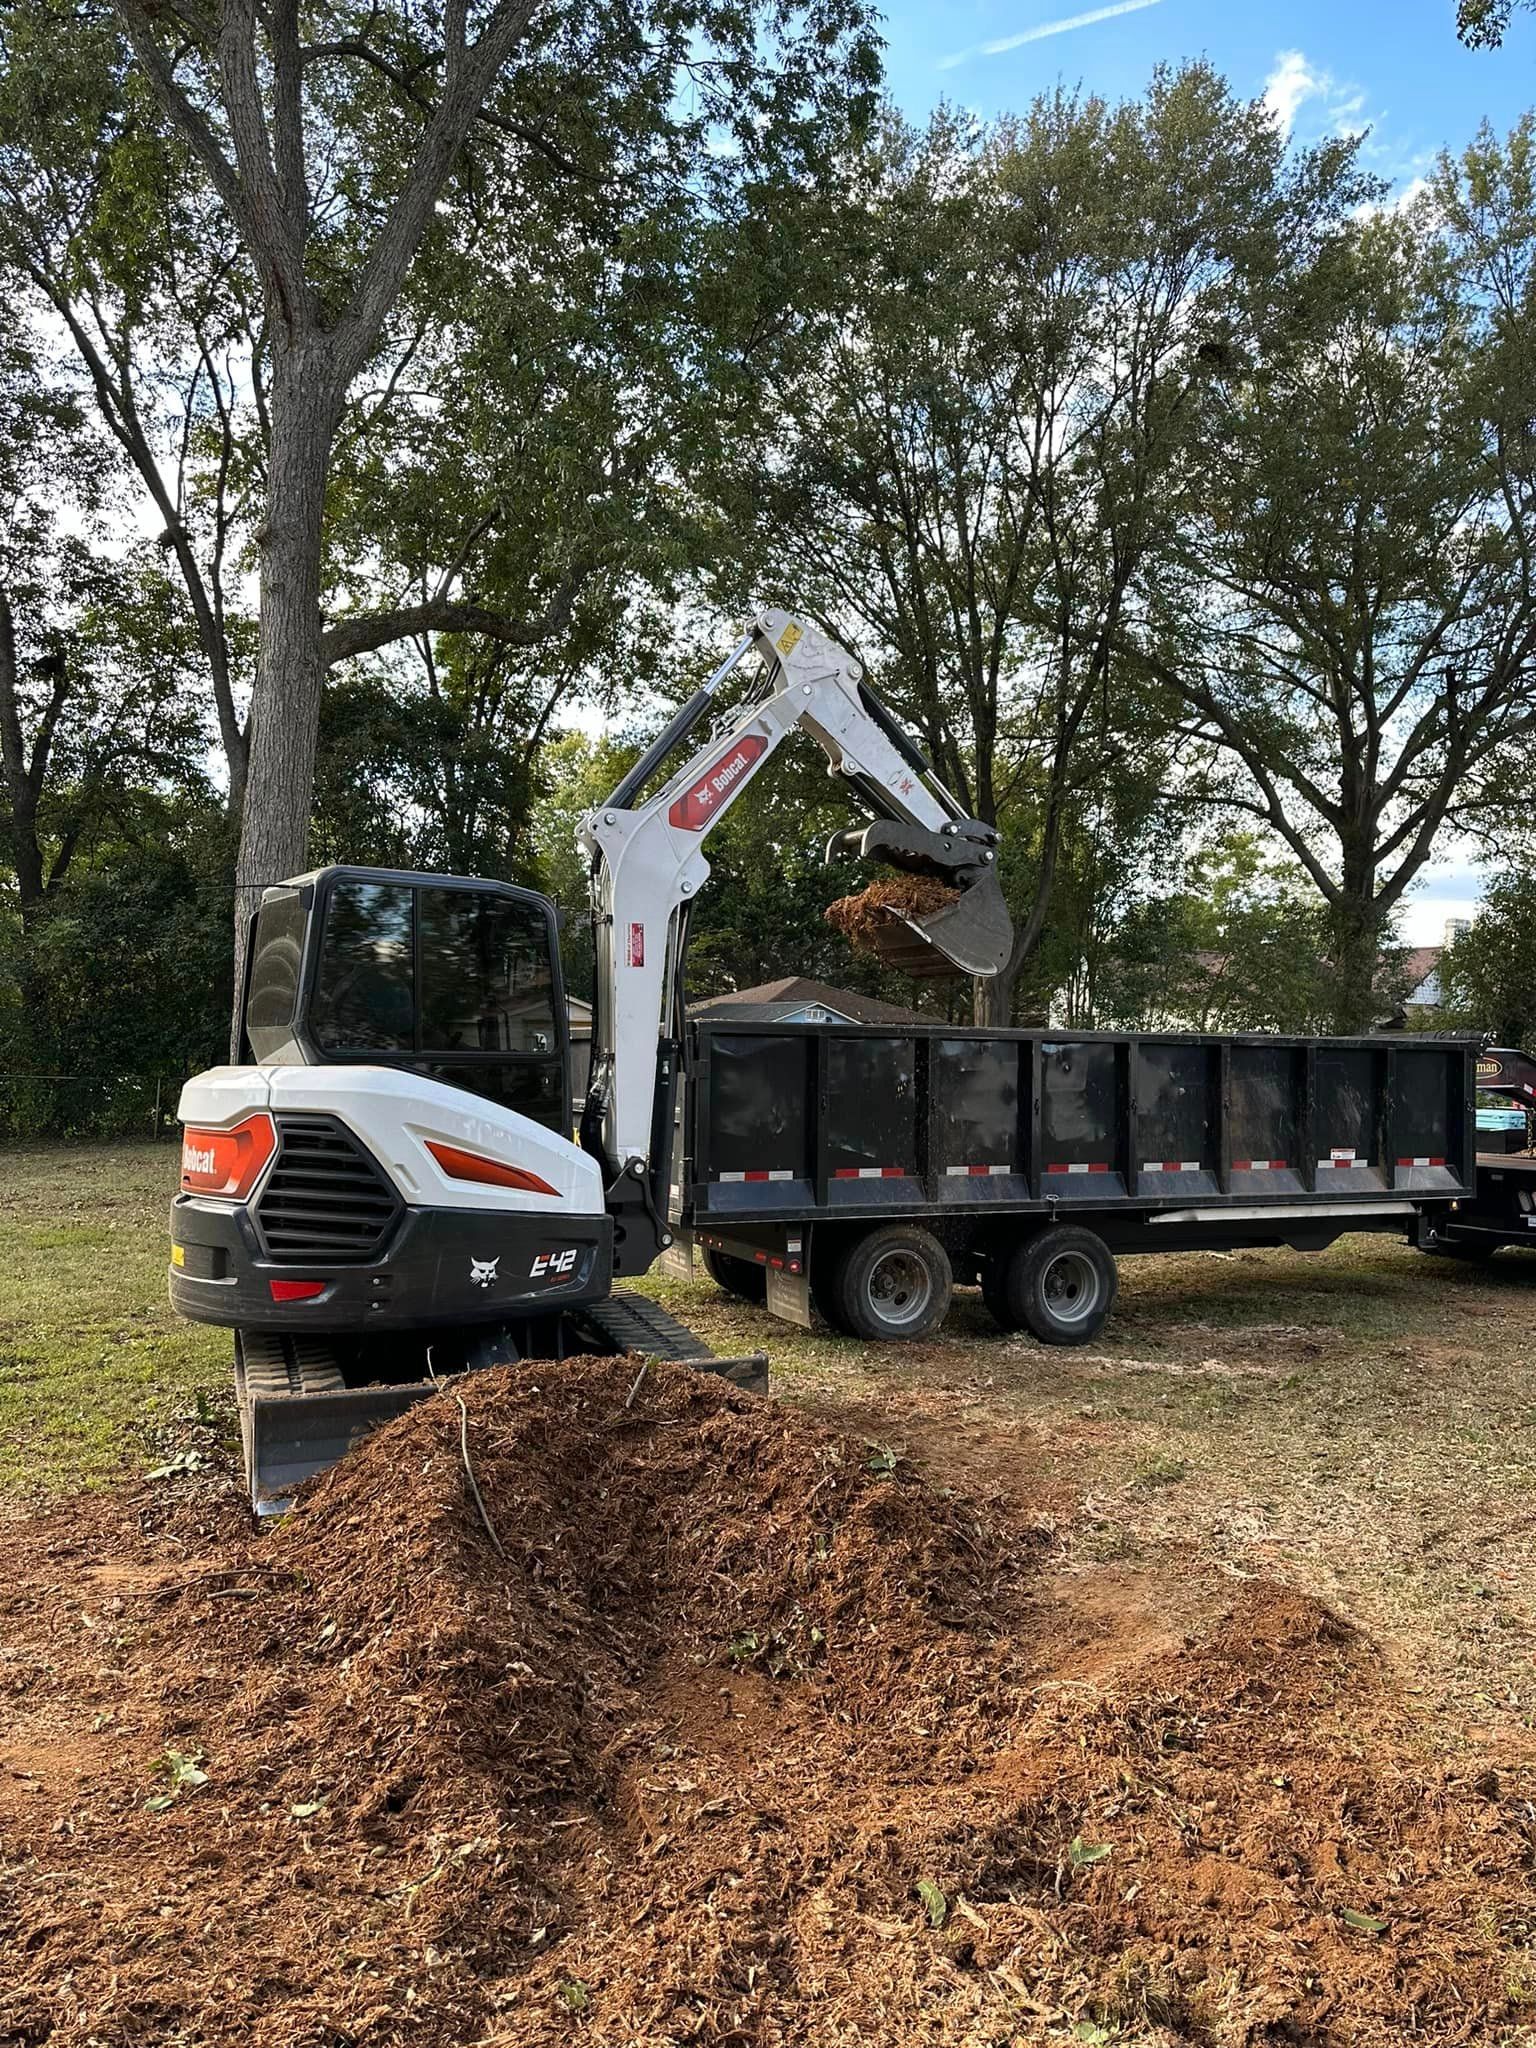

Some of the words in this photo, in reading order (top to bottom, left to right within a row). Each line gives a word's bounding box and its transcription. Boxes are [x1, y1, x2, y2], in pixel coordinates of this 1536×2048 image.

[711, 752, 748, 793] Bobcat
[1476, 1063, 1497, 1073] man
[529, 1249, 577, 1278] E42
